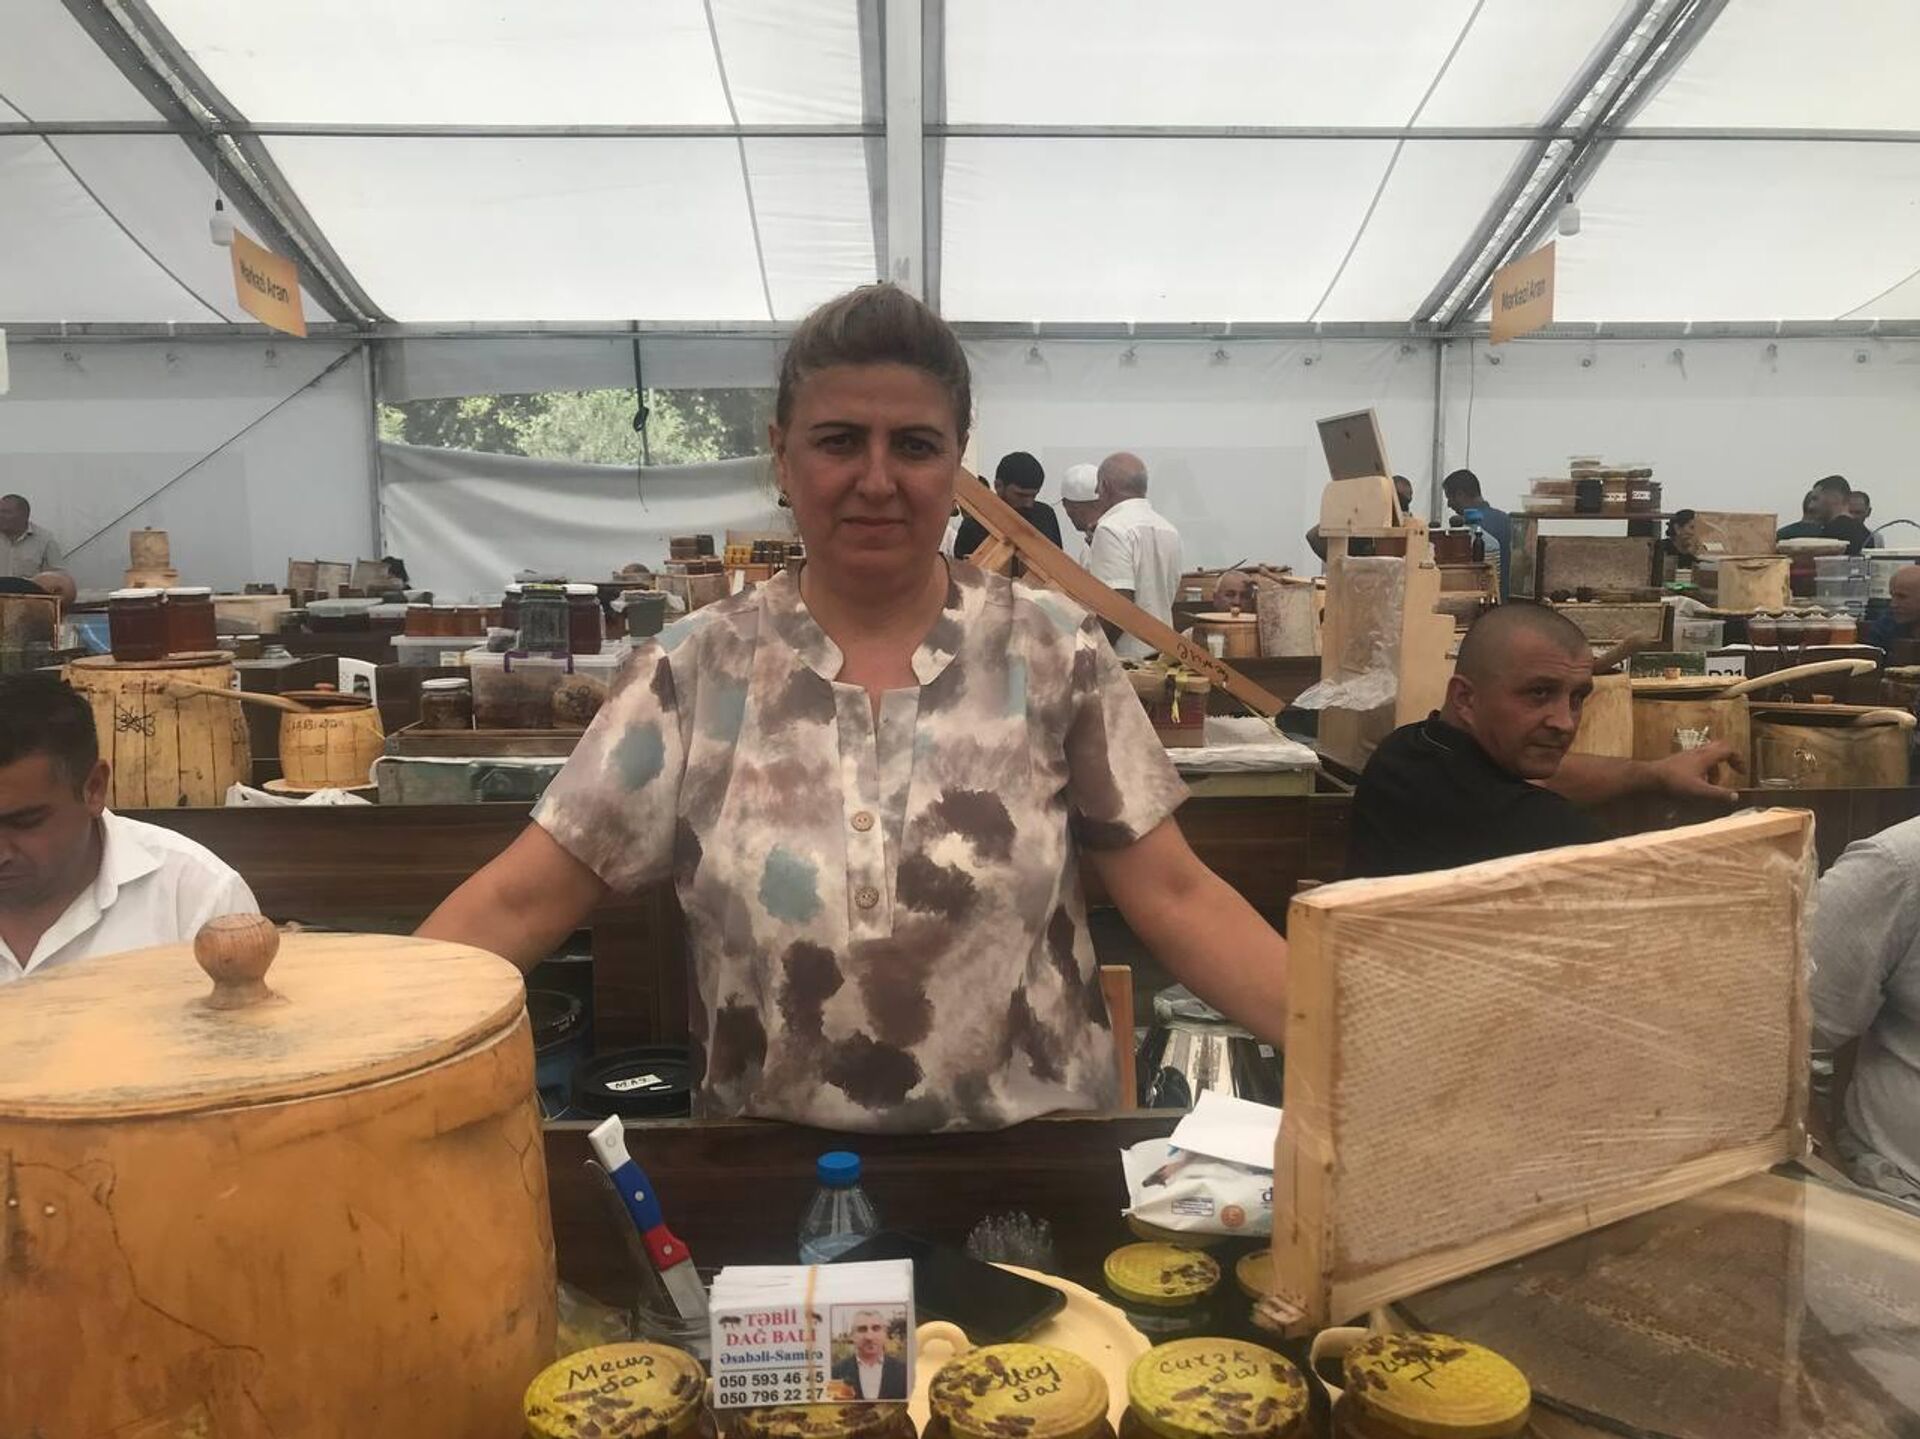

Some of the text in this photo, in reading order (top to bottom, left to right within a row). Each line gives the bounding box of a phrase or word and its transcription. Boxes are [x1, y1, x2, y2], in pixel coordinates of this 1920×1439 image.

[726, 1328, 767, 1347] DAĞ
[720, 1375, 747, 1388] 050
[751, 1373, 778, 1387] 593
[783, 1372, 802, 1385] 46
[720, 1391, 748, 1404] 050
[752, 1390, 779, 1403] 796
[783, 1388, 802, 1401] 22
